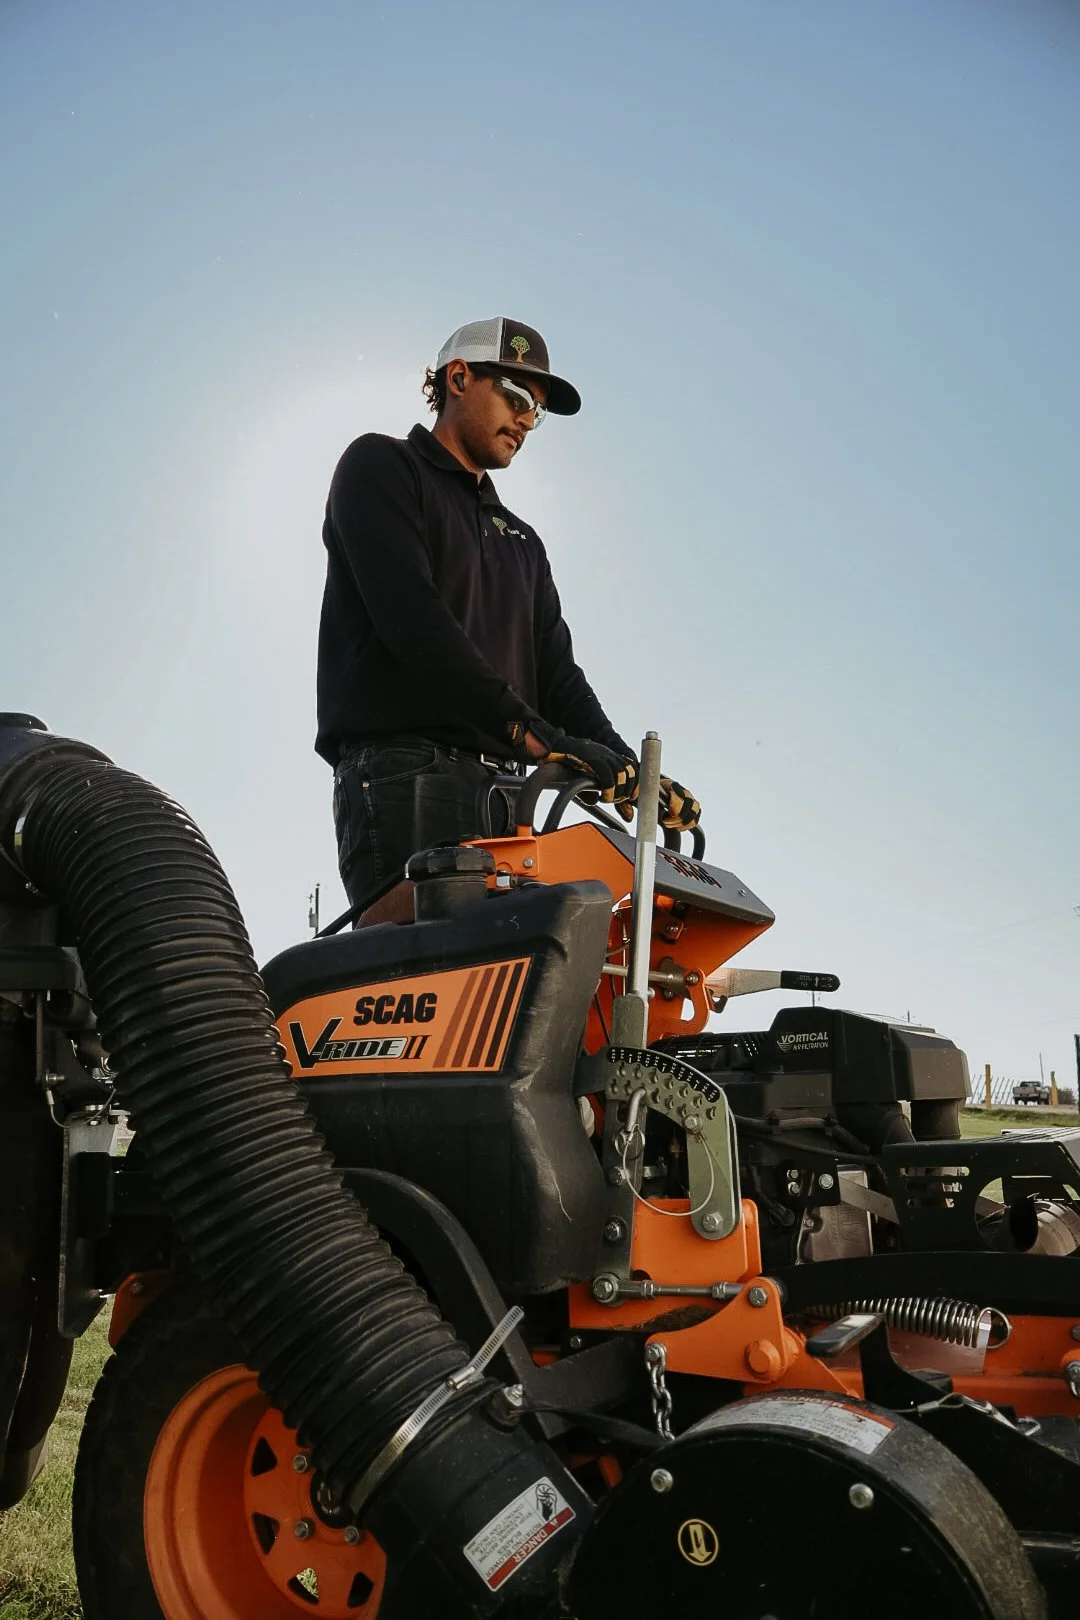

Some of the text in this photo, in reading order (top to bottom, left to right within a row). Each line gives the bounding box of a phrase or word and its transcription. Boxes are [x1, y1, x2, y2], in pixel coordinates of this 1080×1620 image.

[353, 992, 438, 1026] SCAG
[781, 1032, 829, 1043] VORTICAL
[802, 1042, 829, 1050] FILTRATION
[776, 1396, 844, 1408] DANGER
[512, 1528, 548, 1563] DANGER
